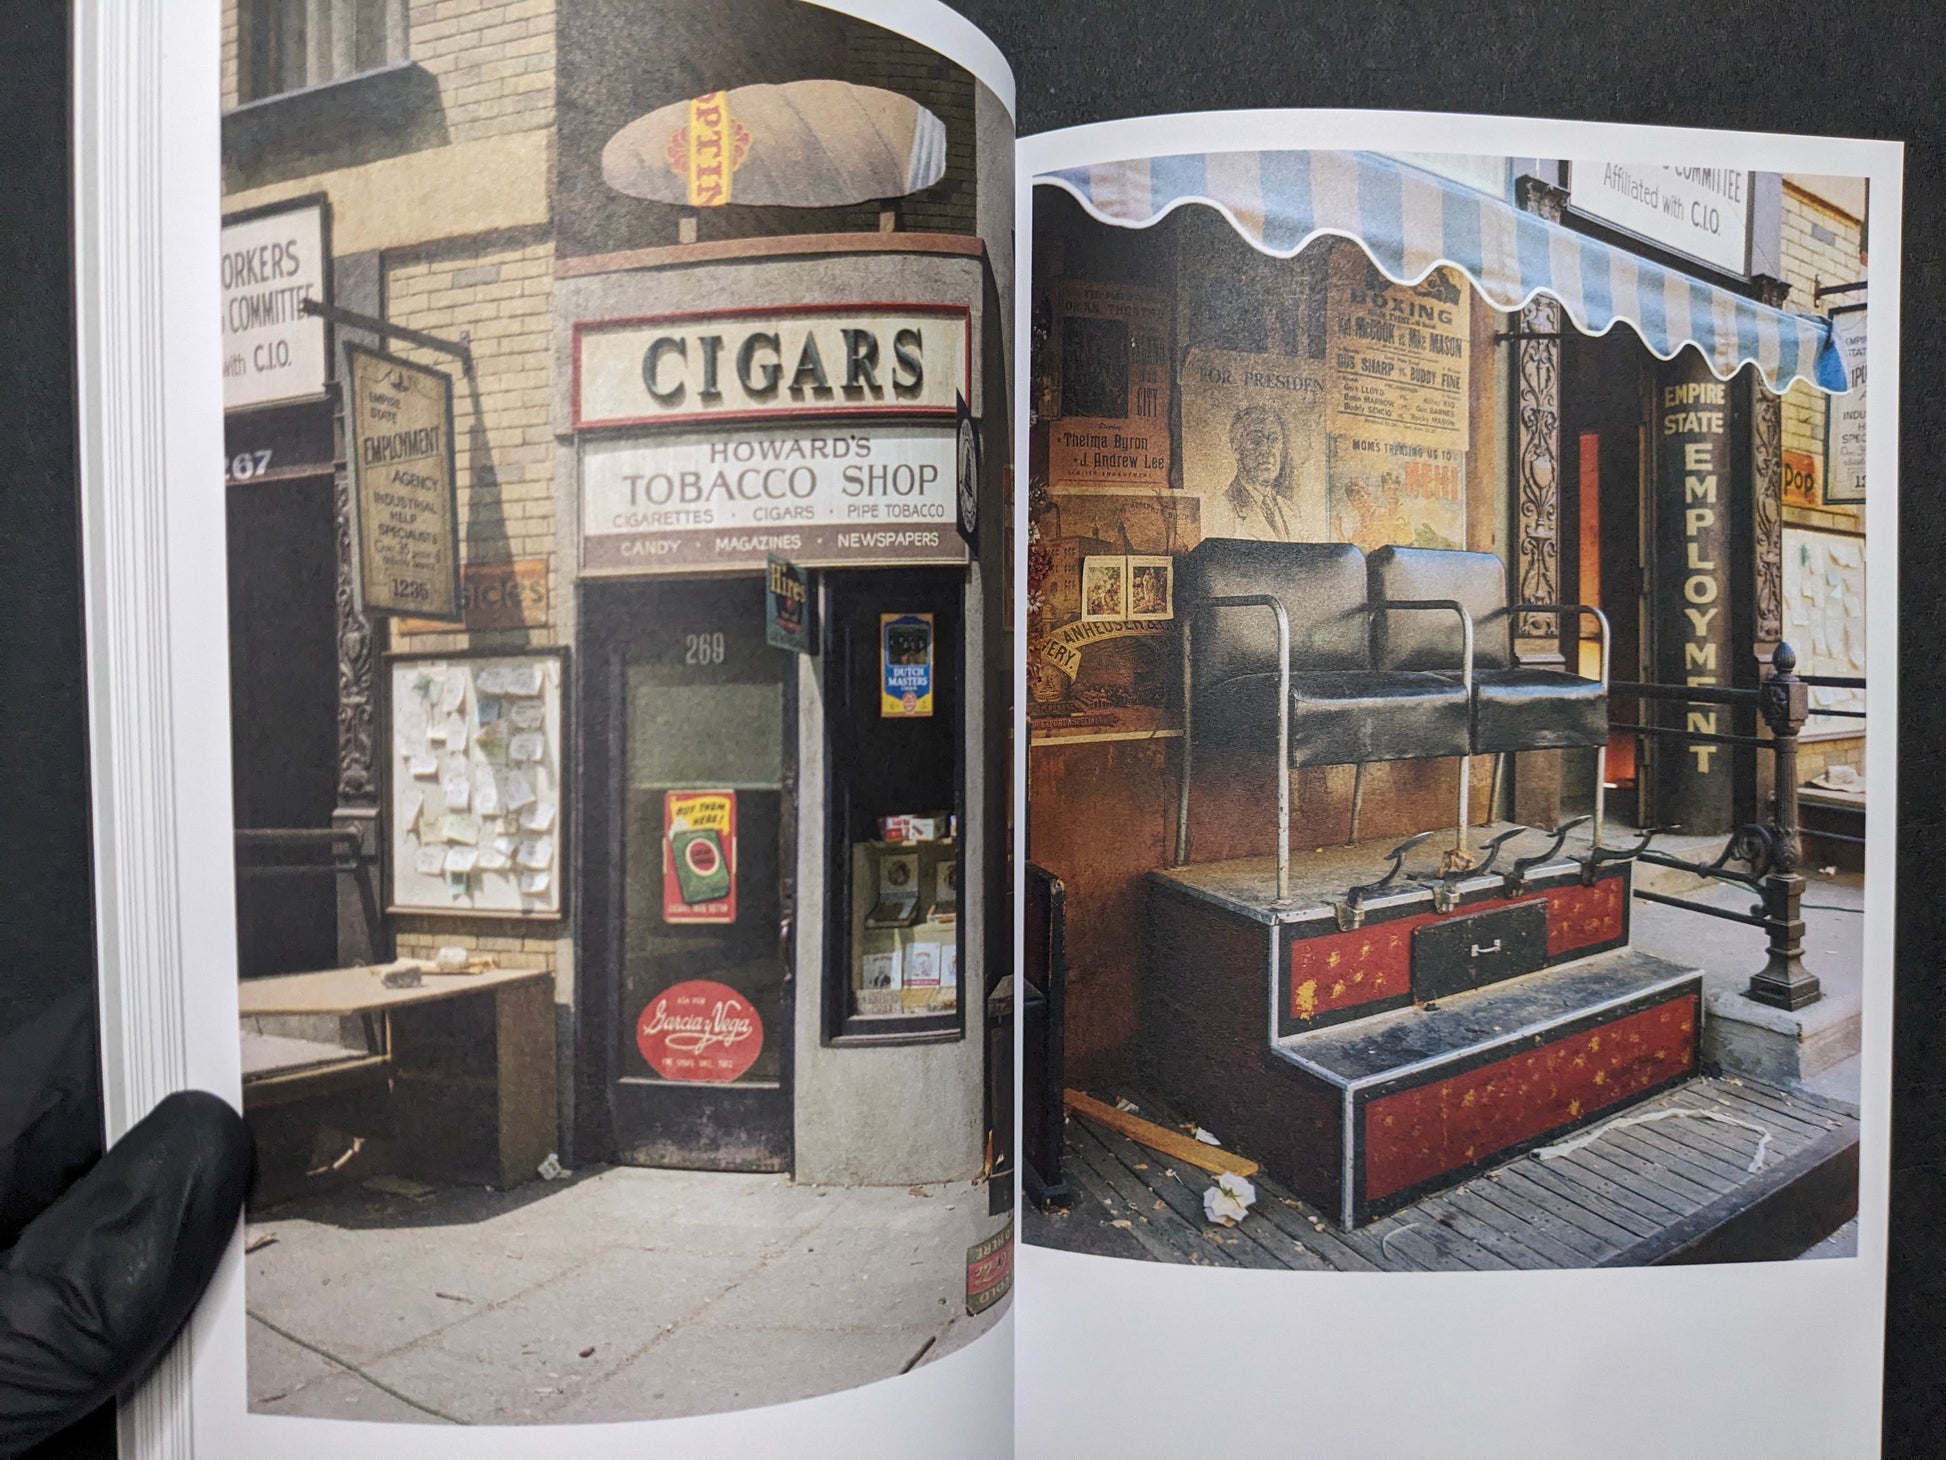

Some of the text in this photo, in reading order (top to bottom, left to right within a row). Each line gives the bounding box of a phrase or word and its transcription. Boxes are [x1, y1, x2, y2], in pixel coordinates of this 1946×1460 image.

[693, 90, 723, 205] PTI
[1603, 162, 1659, 207] Affiliated
[1662, 195, 1684, 220] with
[1430, 331, 1462, 359] MASON
[641, 328, 924, 405] CIGARS
[1362, 358, 1395, 377] SHARP
[1442, 373, 1461, 390] FINE
[1664, 382, 1726, 408] EMPIRE
[1663, 410, 1725, 435] STATE
[364, 425, 439, 465] EMPLOYMENT
[710, 434, 872, 463] HOWARD'S
[1063, 431, 1149, 451] Thelma Byron
[1352, 439, 1381, 453] MOMS
[225, 448, 273, 481] 67
[1093, 455, 1139, 472] Andrew
[1143, 457, 1166, 470] Lee
[392, 470, 438, 491] AGENCY
[621, 463, 939, 506] TOBACCO SHOP
[612, 503, 945, 529] CIGARETTES CIGARS PIPE TOBACCO
[620, 531, 940, 557] CANDY MAGAZINES NEWSPAPERS
[686, 631, 725, 666] 269
[888, 677, 928, 687] MASTERS
[893, 668, 925, 677] DUTCH
[643, 999, 704, 1035] Garcia
[711, 999, 753, 1048] Vega
